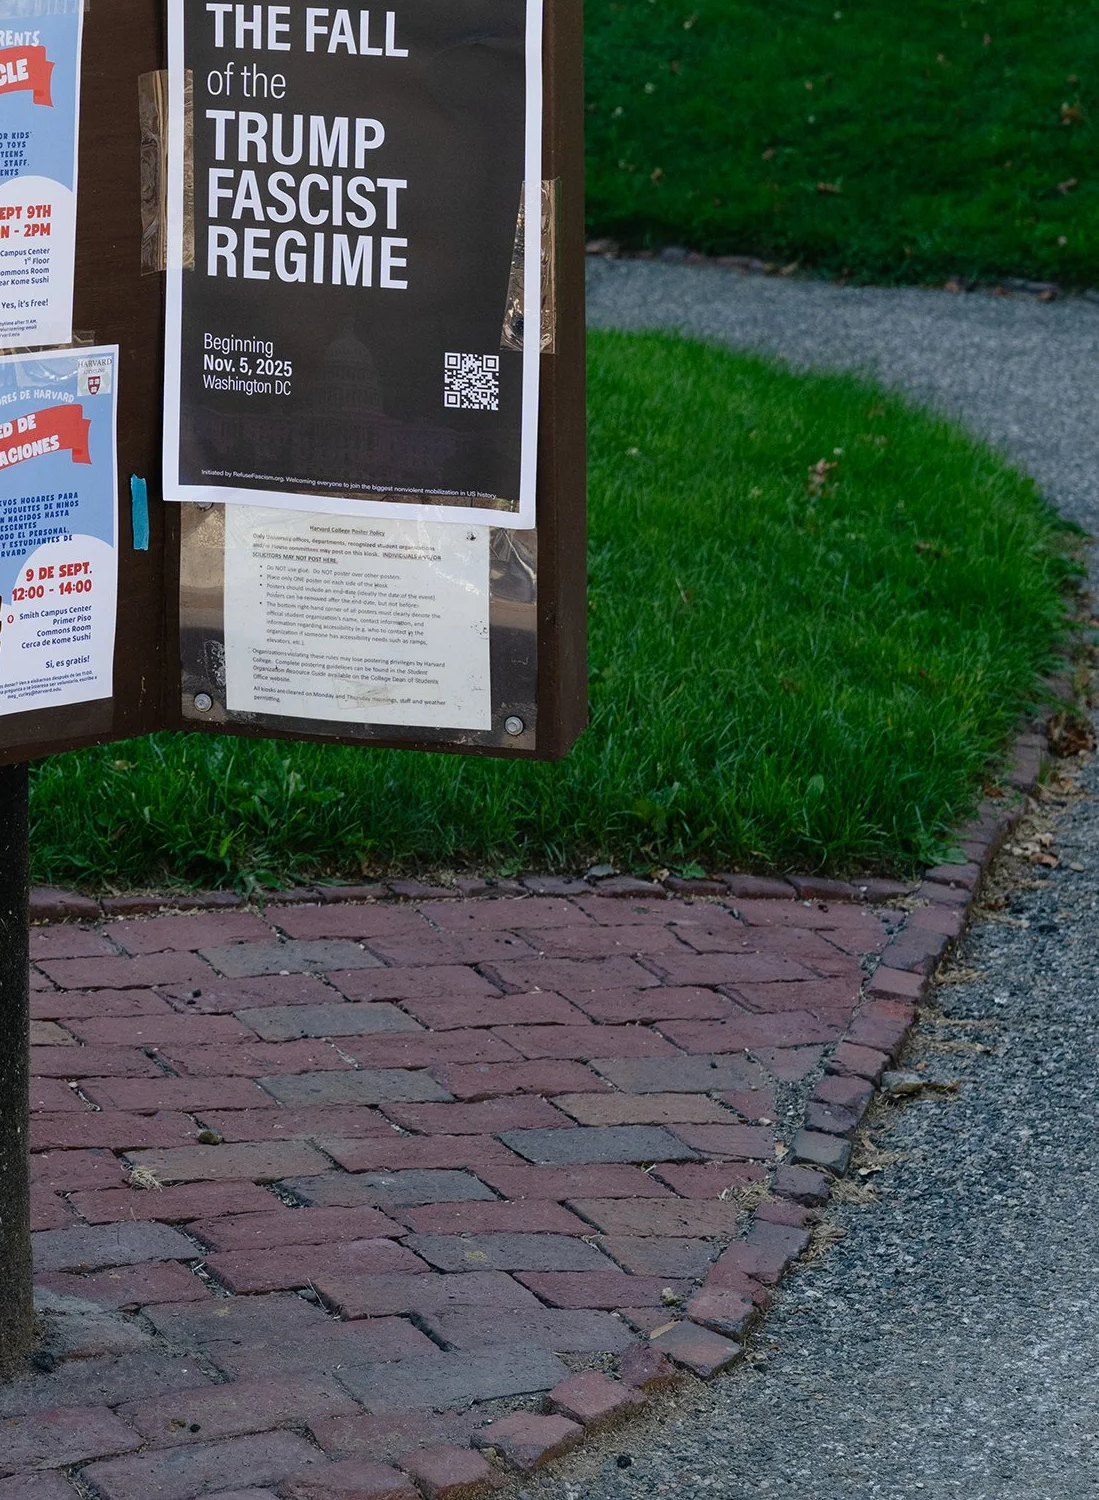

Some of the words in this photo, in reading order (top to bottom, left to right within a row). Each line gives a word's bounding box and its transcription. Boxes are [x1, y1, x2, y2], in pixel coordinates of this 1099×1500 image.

[205, 3, 291, 51] THE
[305, 7, 409, 58] FALL
[207, 61, 234, 96] of
[241, 63, 286, 99] the
[205, 109, 385, 169] TRUMP
[208, 167, 408, 230] FASCIST
[27, 204, 51, 218] 9TH
[24, 222, 50, 237] 2PM
[0, 248, 26, 258] Campus
[28, 247, 50, 256] Center
[207, 225, 408, 290] REGIME
[204, 333, 273, 357] Beginning
[203, 355, 235, 372] Nov.
[239, 357, 252, 376] 5,
[256, 359, 293, 377] 2025
[203, 375, 272, 395] Washington
[275, 380, 291, 396] DC
[17, 414, 36, 433] DE
[233, 471, 285, 482] RefuseFascism.org.
[286, 476, 316, 487] Welcoming
[372, 484, 393, 493] biggest
[425, 488, 459, 496] mobilization
[477, 492, 497, 500] history.
